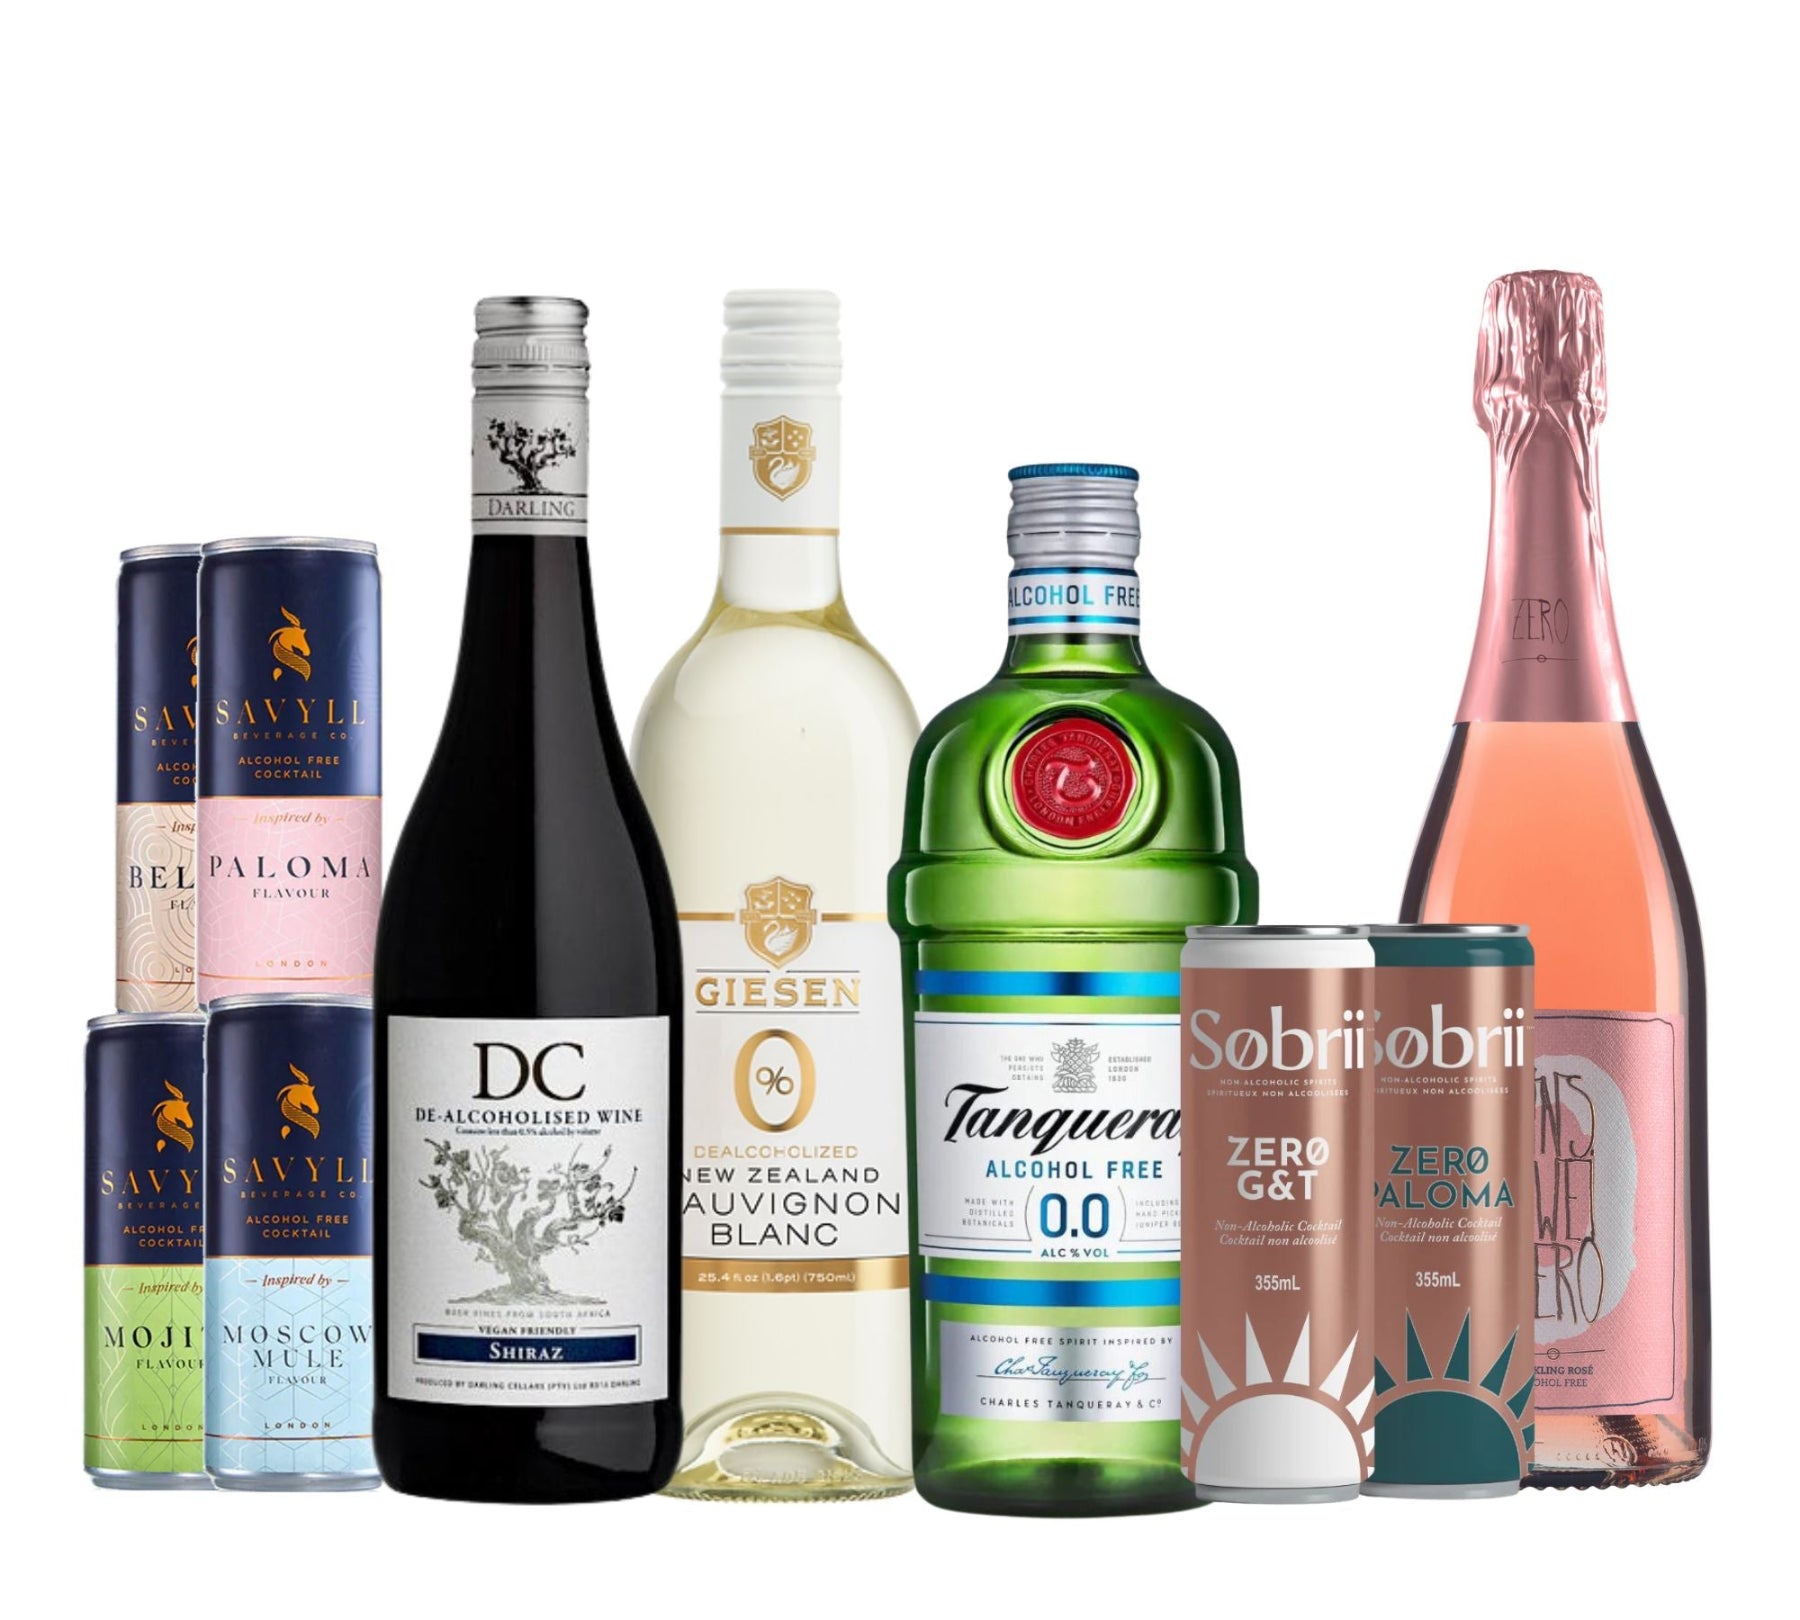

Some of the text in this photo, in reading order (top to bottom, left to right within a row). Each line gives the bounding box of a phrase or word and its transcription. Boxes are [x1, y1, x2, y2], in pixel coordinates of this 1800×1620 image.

[1008, 584, 1095, 608] ALCOHOL
[1512, 598, 1569, 644] ZERO
[216, 698, 366, 725] SAVYLL
[233, 732, 318, 740] BEVERAGE
[238, 756, 340, 765] ALCOHOL FREE
[254, 770, 322, 779] COCKTAIL
[253, 812, 329, 827] Inspired by
[210, 855, 371, 878] PALOMA
[252, 888, 330, 899] FLAVOUR
[255, 960, 328, 968] LONDON
[695, 977, 861, 1008] GIESEN
[472, 1041, 587, 1101] DC
[1262, 1089, 1285, 1097] NON
[1422, 1087, 1445, 1095] NON
[415, 1107, 643, 1125] DE-ALCOHOLISED WINE
[944, 1082, 1181, 1157] Tanquera
[694, 1145, 859, 1159] DEALCOHOLIZED
[223, 1156, 373, 1184] SAVYLL
[748, 1166, 880, 1184] ZEALAND
[985, 1159, 1163, 1180] ALCOHOL FREE
[101, 1169, 200, 1196] SAVY
[1237, 1169, 1319, 1201] G&T
[240, 1190, 327, 1199] BEVERAGE
[1374, 1177, 1515, 1210] ALOMA
[991, 1198, 1015, 1207] WITH
[245, 1215, 350, 1224] ALCOHOL FREE
[1214, 1218, 1344, 1232] Non-Alcoholic Cocktail
[1375, 1216, 1503, 1229] Non-Alcoholic Cocktail
[123, 1225, 184, 1234] ALCOHOL
[262, 1229, 331, 1238] COCKTAIL
[711, 1223, 839, 1247] BLANC
[1380, 1230, 1425, 1243] Cocktail
[1427, 1233, 1450, 1243] non
[138, 1239, 205, 1248] COCKTAIL
[1219, 1234, 1266, 1246] Cocktail
[1267, 1237, 1289, 1246] non
[1040, 1248, 1110, 1258] ALC % VOL
[262, 1273, 332, 1289] Inspired by
[697, 1272, 730, 1282] 25.4
[1254, 1274, 1301, 1291] 355mL
[1415, 1271, 1461, 1287] 355mL
[138, 1281, 189, 1296] Inspired
[104, 1325, 204, 1349] MOJI
[223, 1325, 372, 1344] MOSCOW
[478, 1325, 577, 1335] VEGAN FRIENDLY
[970, 1334, 1173, 1346] ALCOHOL FREE SPIRIT INSPIRED BY
[253, 1349, 344, 1369] MULE
[1567, 1364, 1594, 1375] ROSÉ
[268, 1376, 327, 1385] FLAVOUR
[1564, 1378, 1588, 1387] FREE
[980, 1396, 1040, 1408] CHARLES
[1047, 1400, 1132, 1410] TANQUERAY
[1136, 1400, 1144, 1408] &
